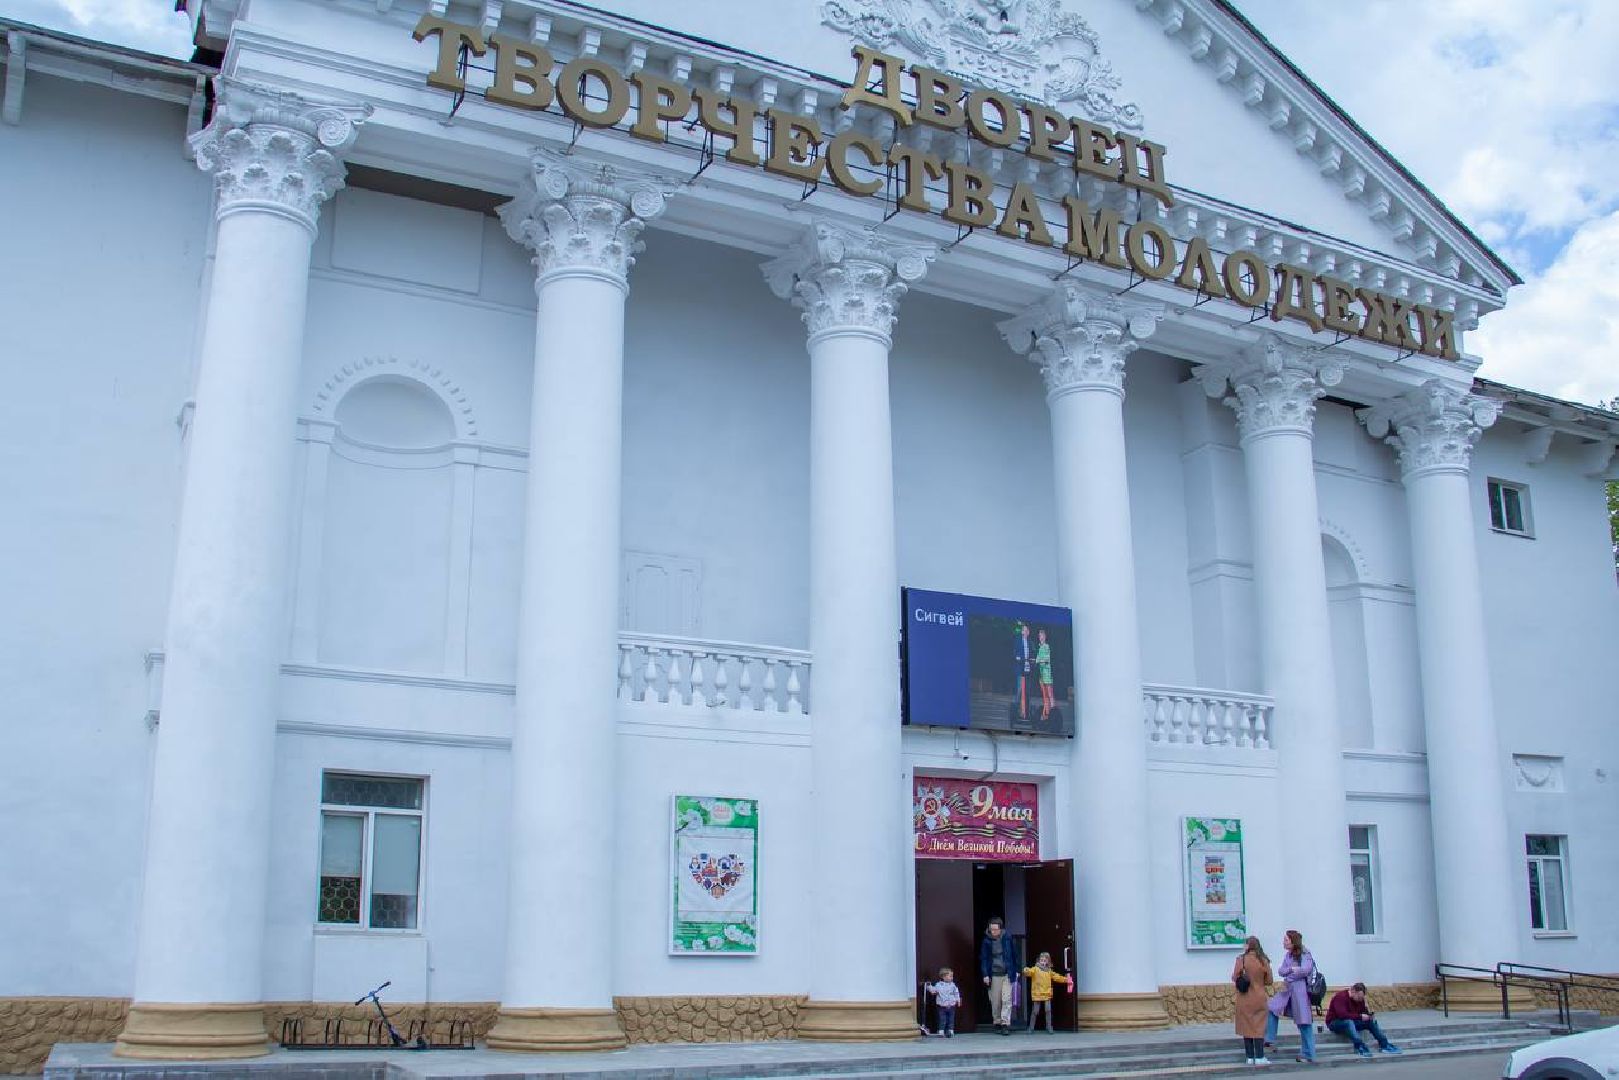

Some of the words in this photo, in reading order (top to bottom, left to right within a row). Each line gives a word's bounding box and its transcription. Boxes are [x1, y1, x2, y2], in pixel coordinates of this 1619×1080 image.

[840, 45, 1174, 208] ДВОРЕЦ
[412, 16, 1054, 247] ТВОРЧЕСТВА
[1062, 196, 1461, 361] МОЛОДЕЖИ
[915, 608, 964, 626] Сигвей
[972, 785, 994, 817] 9
[988, 806, 1033, 821] мая
